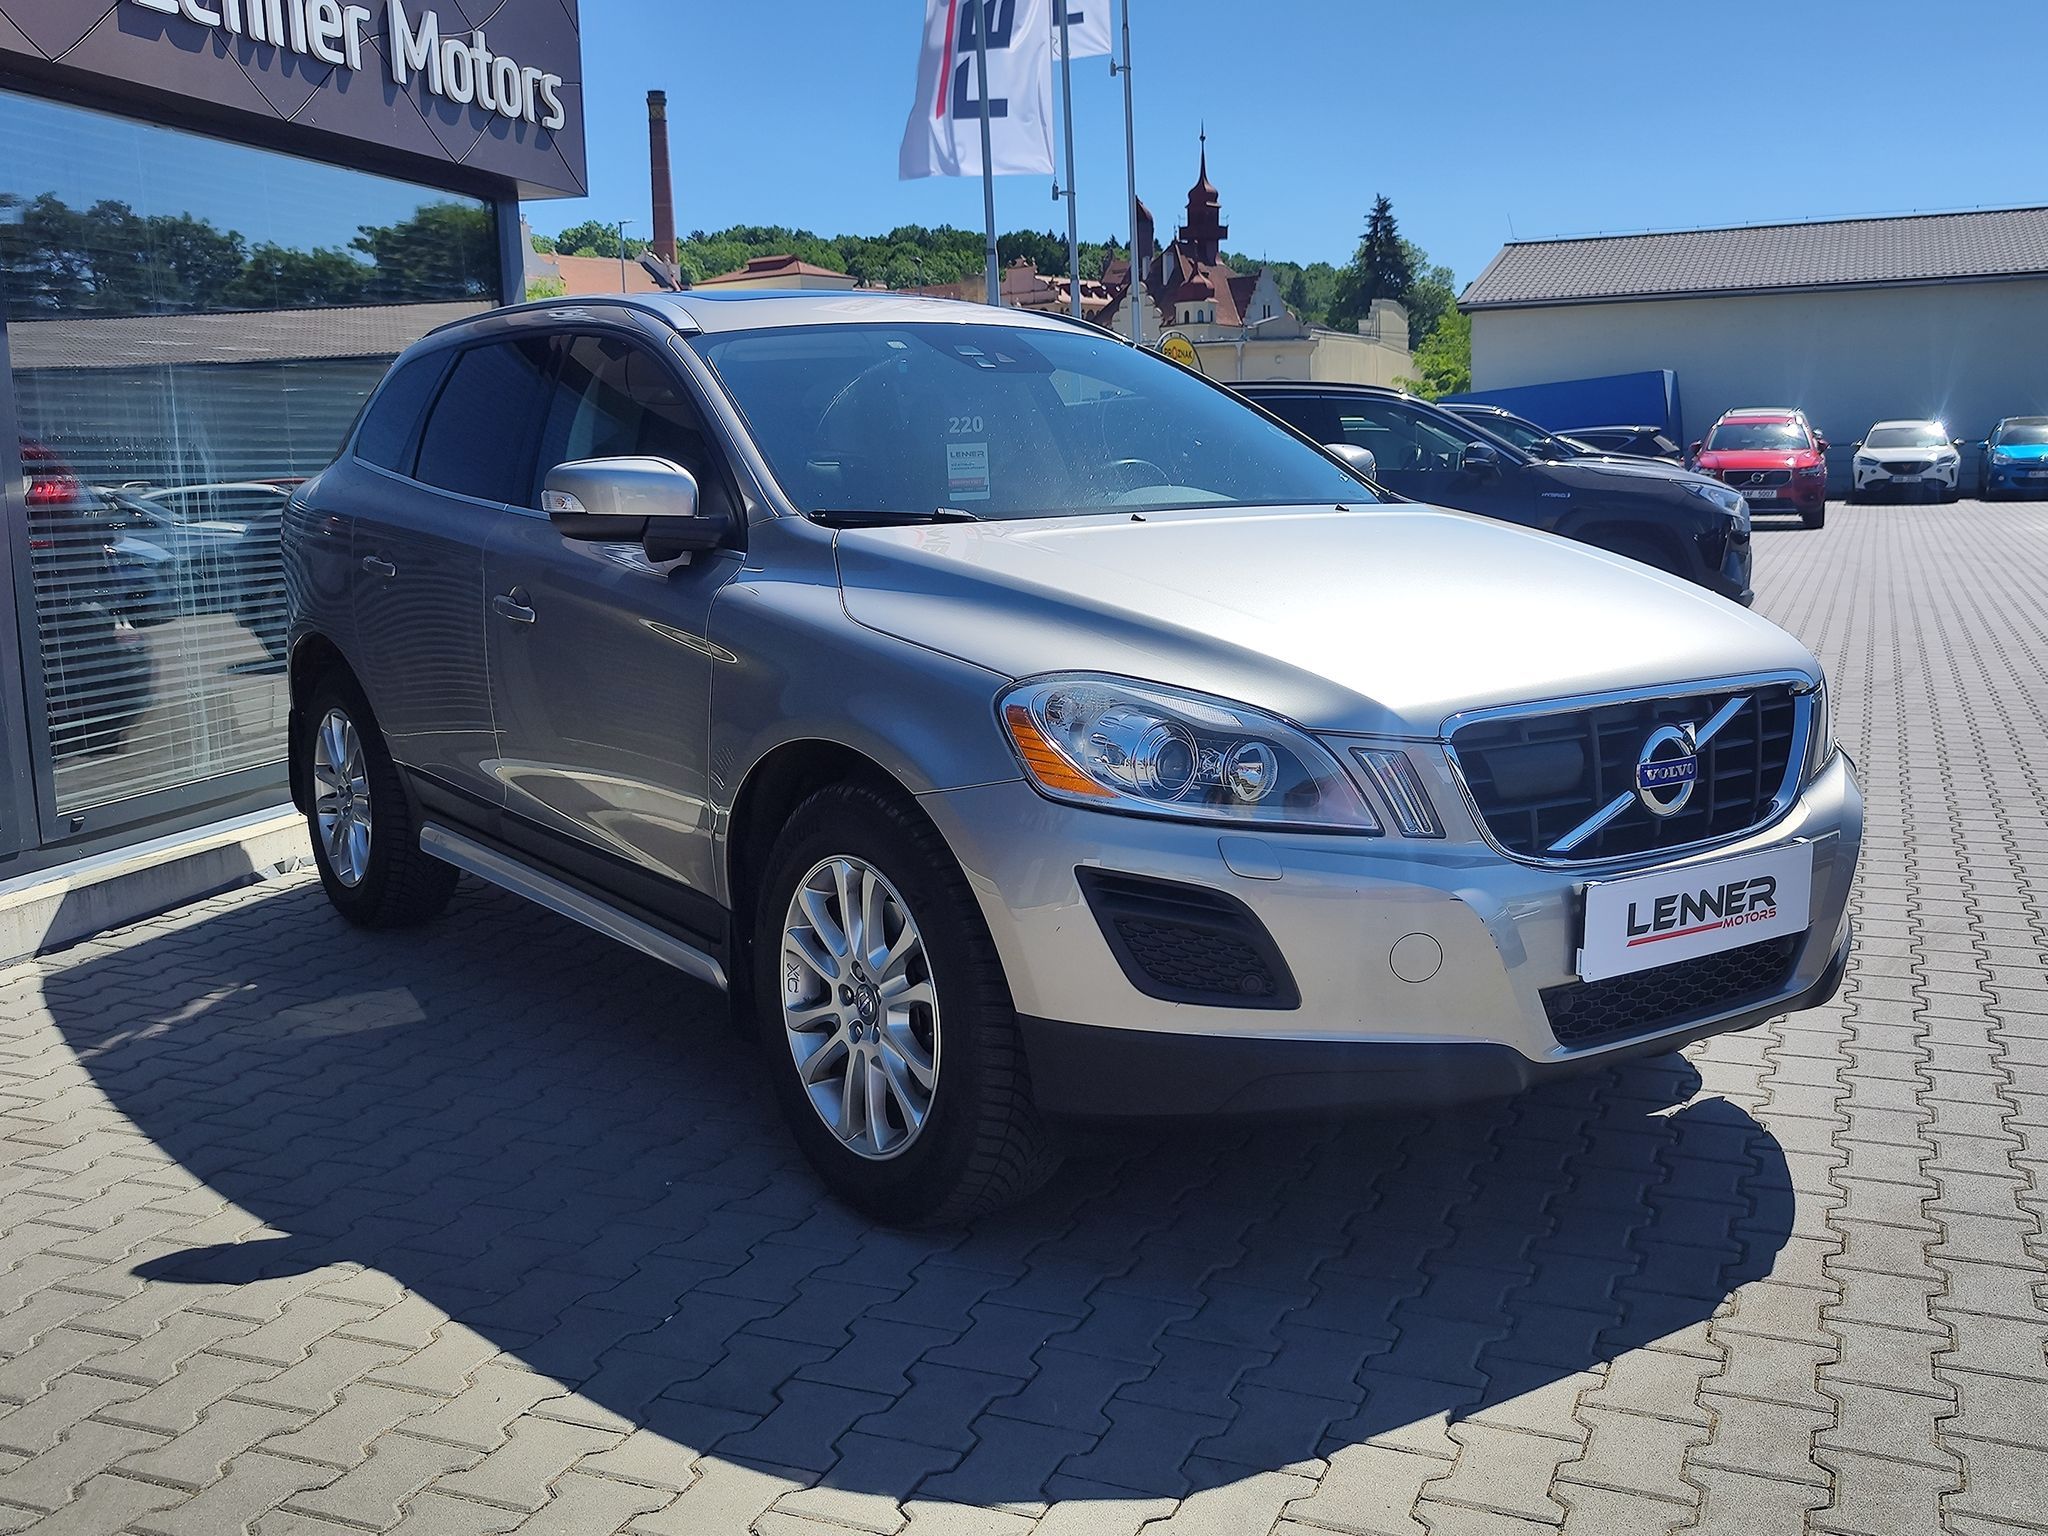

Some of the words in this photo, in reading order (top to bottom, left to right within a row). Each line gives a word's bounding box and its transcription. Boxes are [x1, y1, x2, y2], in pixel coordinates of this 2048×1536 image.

[387, 0, 565, 131] Motors
[948, 415, 984, 434] 220
[1644, 763, 1694, 781] VOLVO
[1627, 876, 1777, 937] LENNER
[1723, 907, 1777, 928] MOTORS
[787, 962, 800, 993] XC
